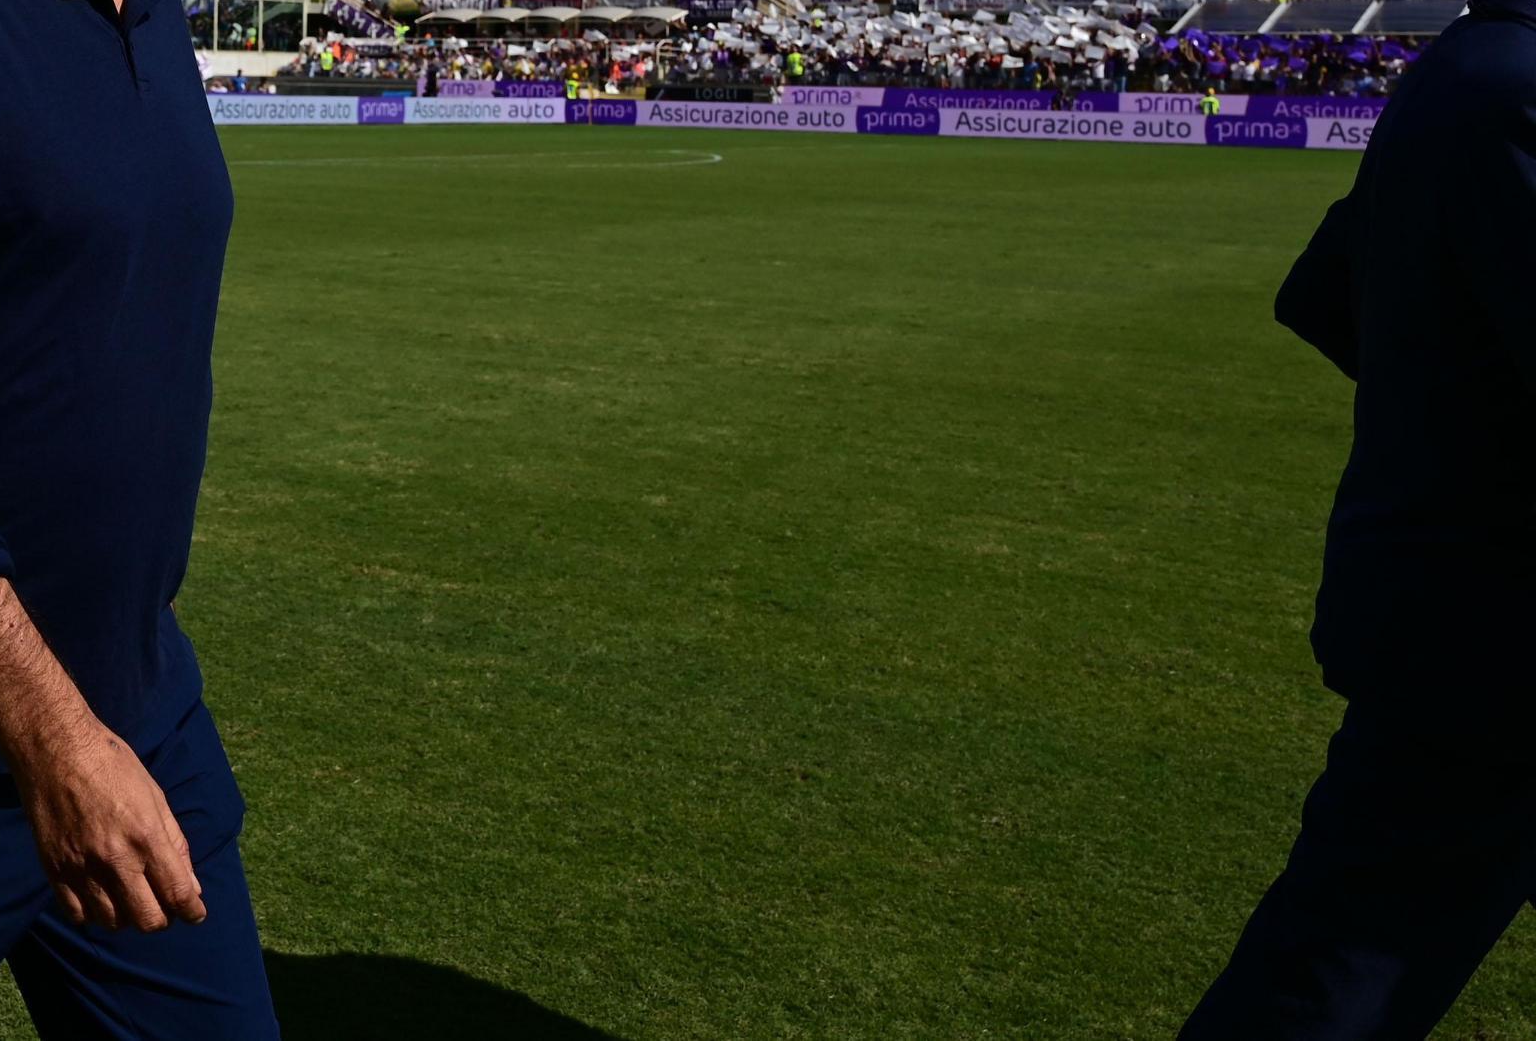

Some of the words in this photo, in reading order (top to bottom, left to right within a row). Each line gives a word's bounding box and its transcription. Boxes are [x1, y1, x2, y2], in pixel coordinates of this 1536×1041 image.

[214, 99, 316, 119] Assicurazione
[319, 102, 351, 119] auto
[413, 101, 502, 118] Assicurazione
[508, 103, 555, 118] auto
[904, 93, 1041, 110] Assicurazione
[649, 103, 789, 124] Assicurazione
[796, 109, 845, 127] auto
[955, 111, 1124, 135] Assicurazione
[1133, 118, 1192, 138] auto
